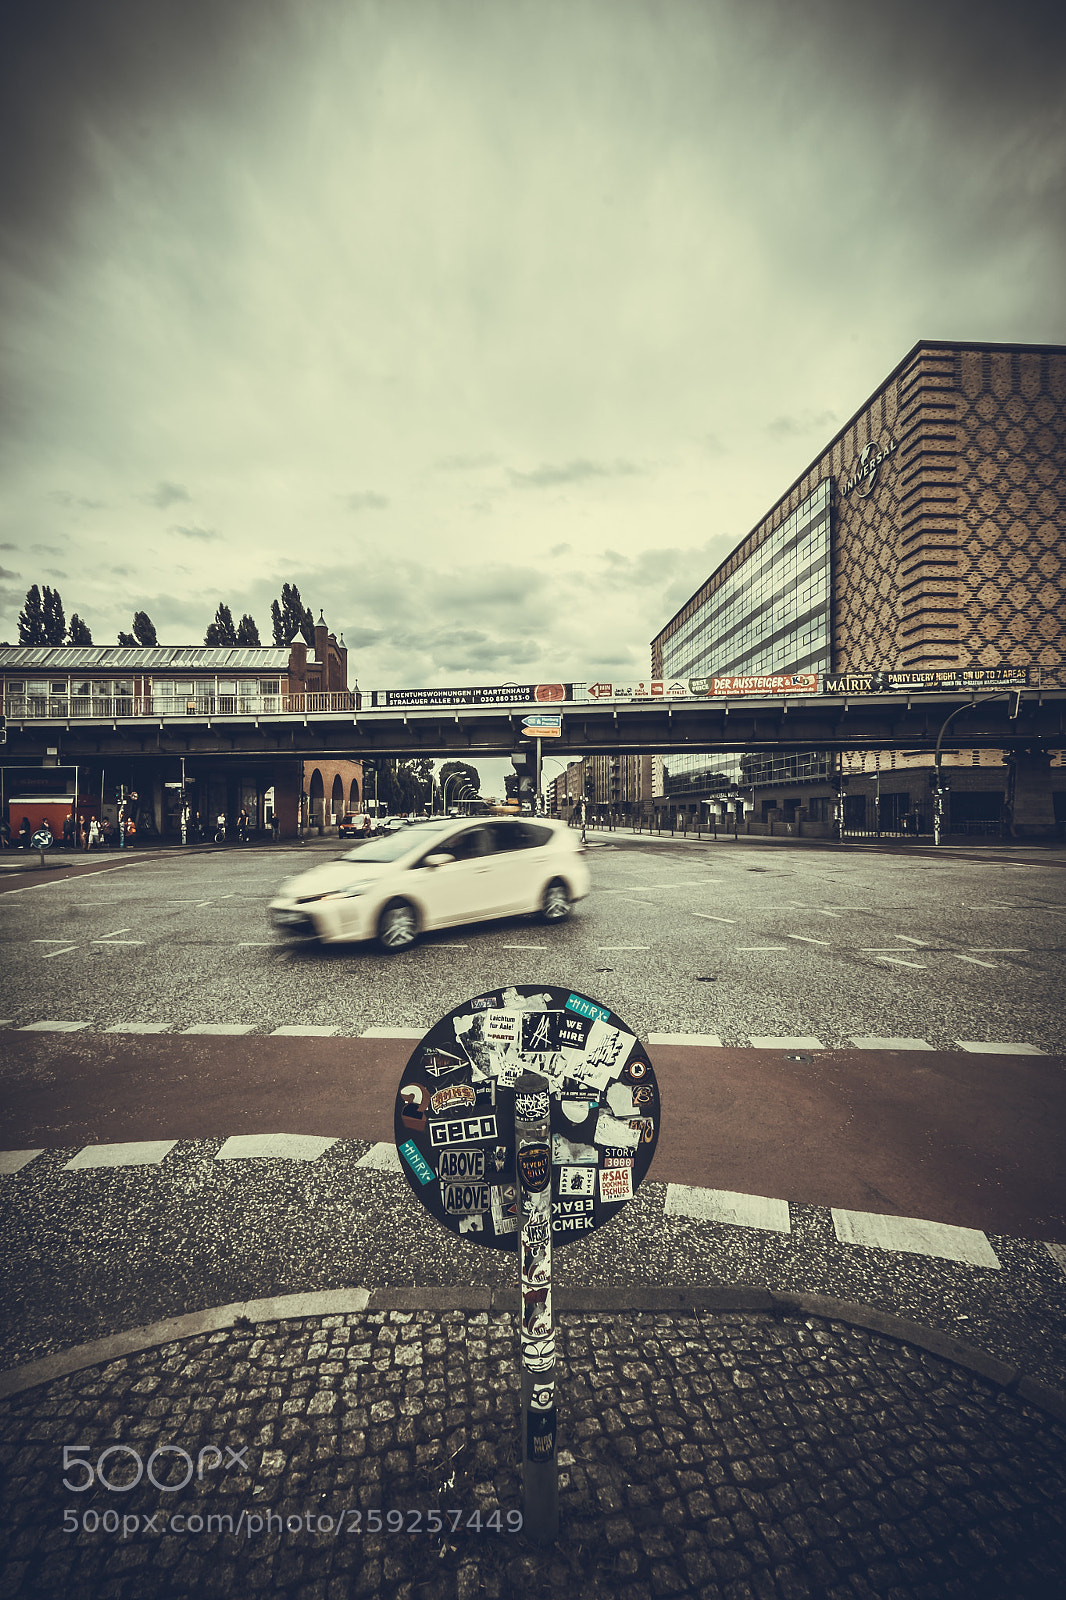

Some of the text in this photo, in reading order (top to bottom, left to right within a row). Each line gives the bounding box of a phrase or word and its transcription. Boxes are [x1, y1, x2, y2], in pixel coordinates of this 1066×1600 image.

[841, 440, 897, 497] UNIVERSAL
[714, 678, 733, 689] DER
[732, 676, 784, 689] AUSSTEIGER
[888, 674, 911, 683] PARTY
[912, 673, 934, 682] EVERY
[936, 671, 957, 681] NIGHT
[974, 671, 985, 680] UP
[986, 670, 995, 679] TO
[996, 670, 1001, 678] 7
[1002, 669, 1026, 678] AREAS
[692, 679, 707, 687] BEST
[826, 677, 872, 692] MATRIX
[389, 690, 471, 699] EIGENTUMSWOHNUNGEN
[482, 687, 530, 695] GARTENHAUS
[389, 698, 428, 706] STRALAUER
[570, 998, 605, 1021] HNRX
[566, 1019, 583, 1031] WE
[558, 1029, 585, 1042] HIRE
[605, 1148, 635, 1157] STORY
[404, 1145, 431, 1179] HNRX
[440, 1152, 484, 1176] ABOVE
[607, 1158, 632, 1167] 3000
[601, 1169, 629, 1181] #SAG
[446, 1185, 489, 1210] ABOVE
